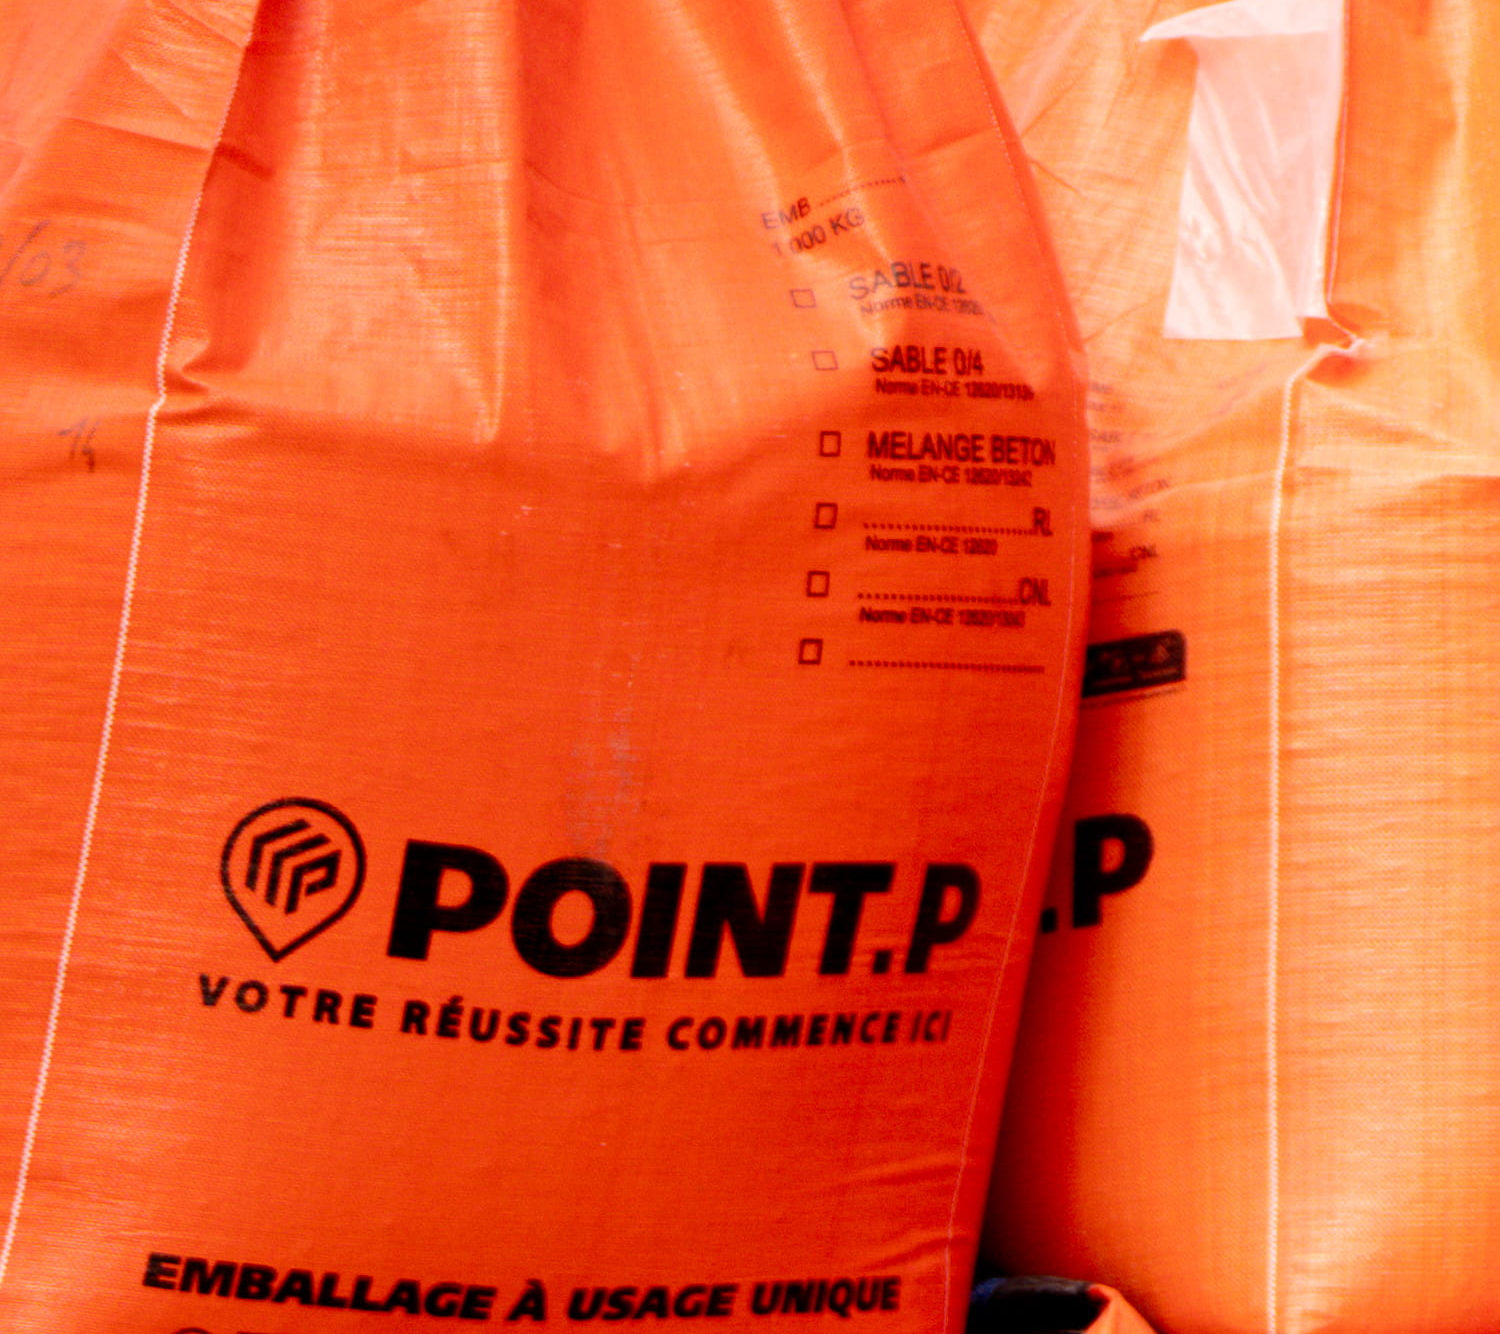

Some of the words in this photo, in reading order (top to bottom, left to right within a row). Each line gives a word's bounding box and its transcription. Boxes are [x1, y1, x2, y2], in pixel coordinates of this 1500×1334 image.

[761, 196, 811, 230] EMB
[788, 225, 827, 255] 000
[829, 206, 865, 235] KG
[849, 261, 935, 301] SABLE
[936, 265, 967, 295] 0/2
[871, 344, 948, 375] SABLE
[952, 346, 984, 376] 0/4
[875, 378, 918, 397] Norme
[867, 430, 985, 463] MELANGE
[990, 433, 1056, 466] BETON
[870, 464, 915, 483] Norme
[865, 535, 912, 552] Norme
[387, 838, 982, 979] POINT.P
[199, 974, 375, 1030] VOTRE
[400, 995, 646, 1053] RÉUSSITE
[667, 1010, 901, 1051] COMMENCE
[909, 1010, 952, 1045] ICI
[142, 1251, 498, 1320] EMBALLAGE
[506, 1278, 548, 1322] À
[566, 1283, 739, 1322] USAGE
[750, 1275, 901, 1317] UNIQUE
